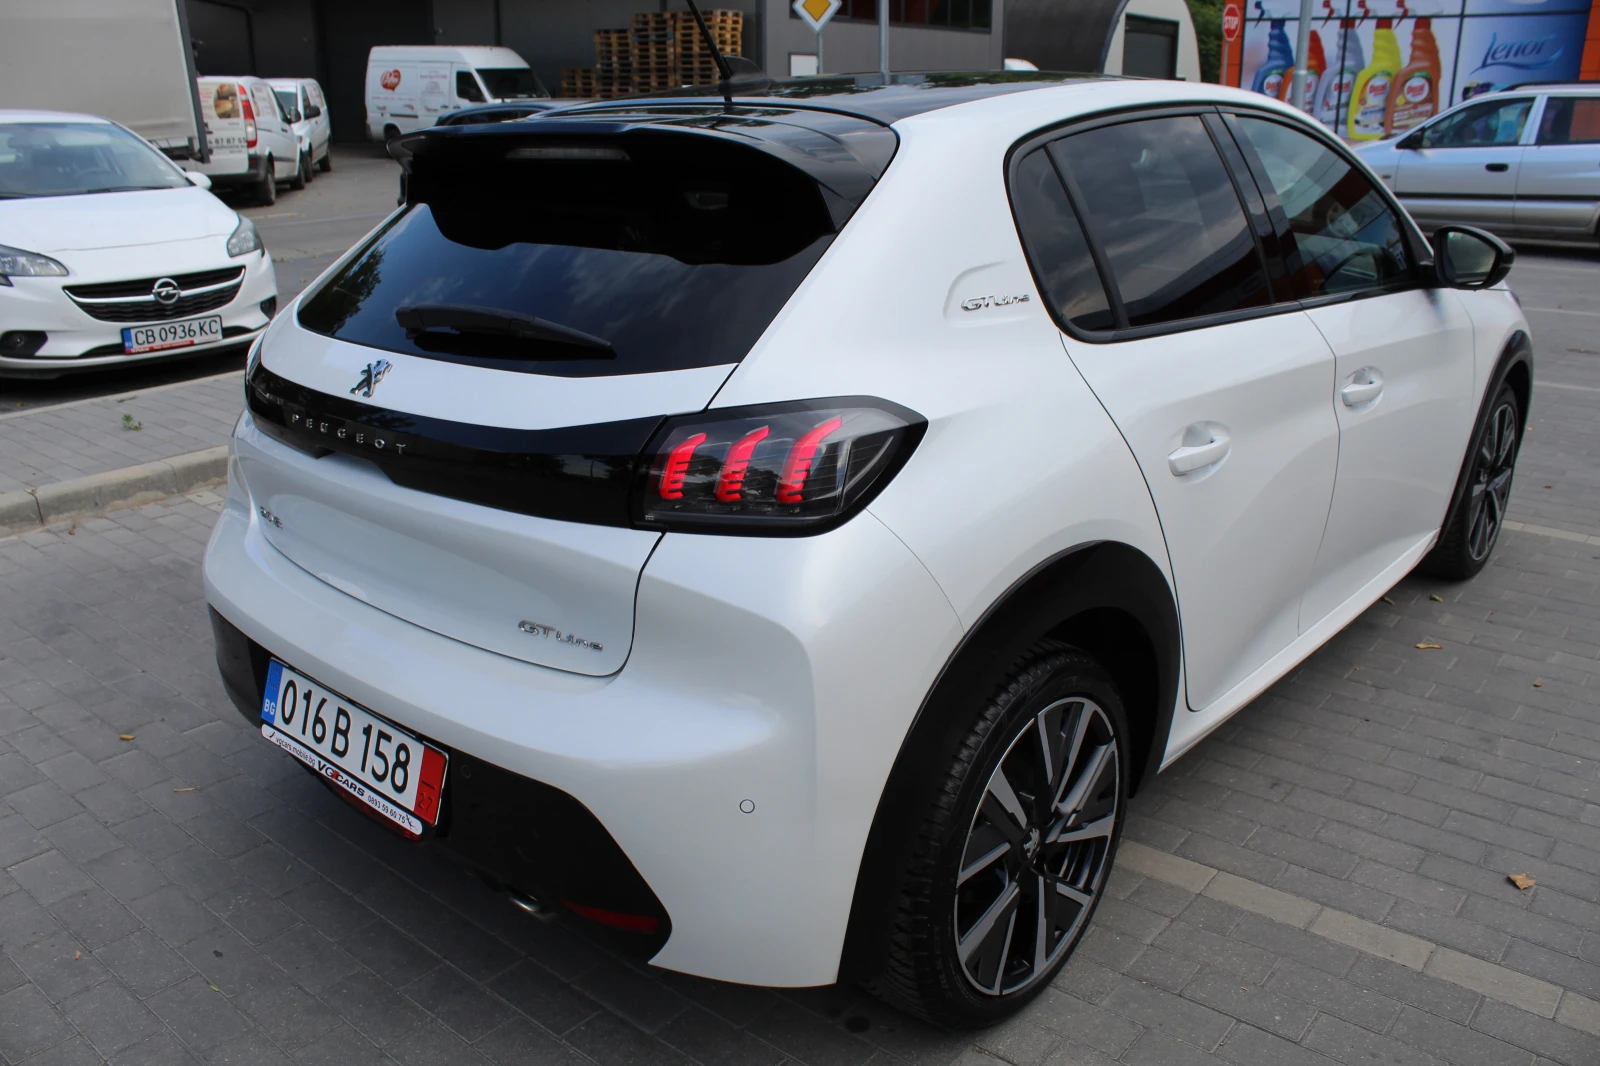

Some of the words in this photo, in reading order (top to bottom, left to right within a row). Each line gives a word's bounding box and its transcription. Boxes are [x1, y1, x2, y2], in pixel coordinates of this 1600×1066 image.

[1224, 16, 1239, 29] STOP
[1480, 32, 1557, 69] Lenor
[134, 328, 156, 346] CB
[159, 322, 197, 342] 0936
[198, 319, 219, 336] KC
[292, 413, 406, 454] PEUGEOT
[263, 697, 276, 716] BG
[417, 792, 433, 812] 27
